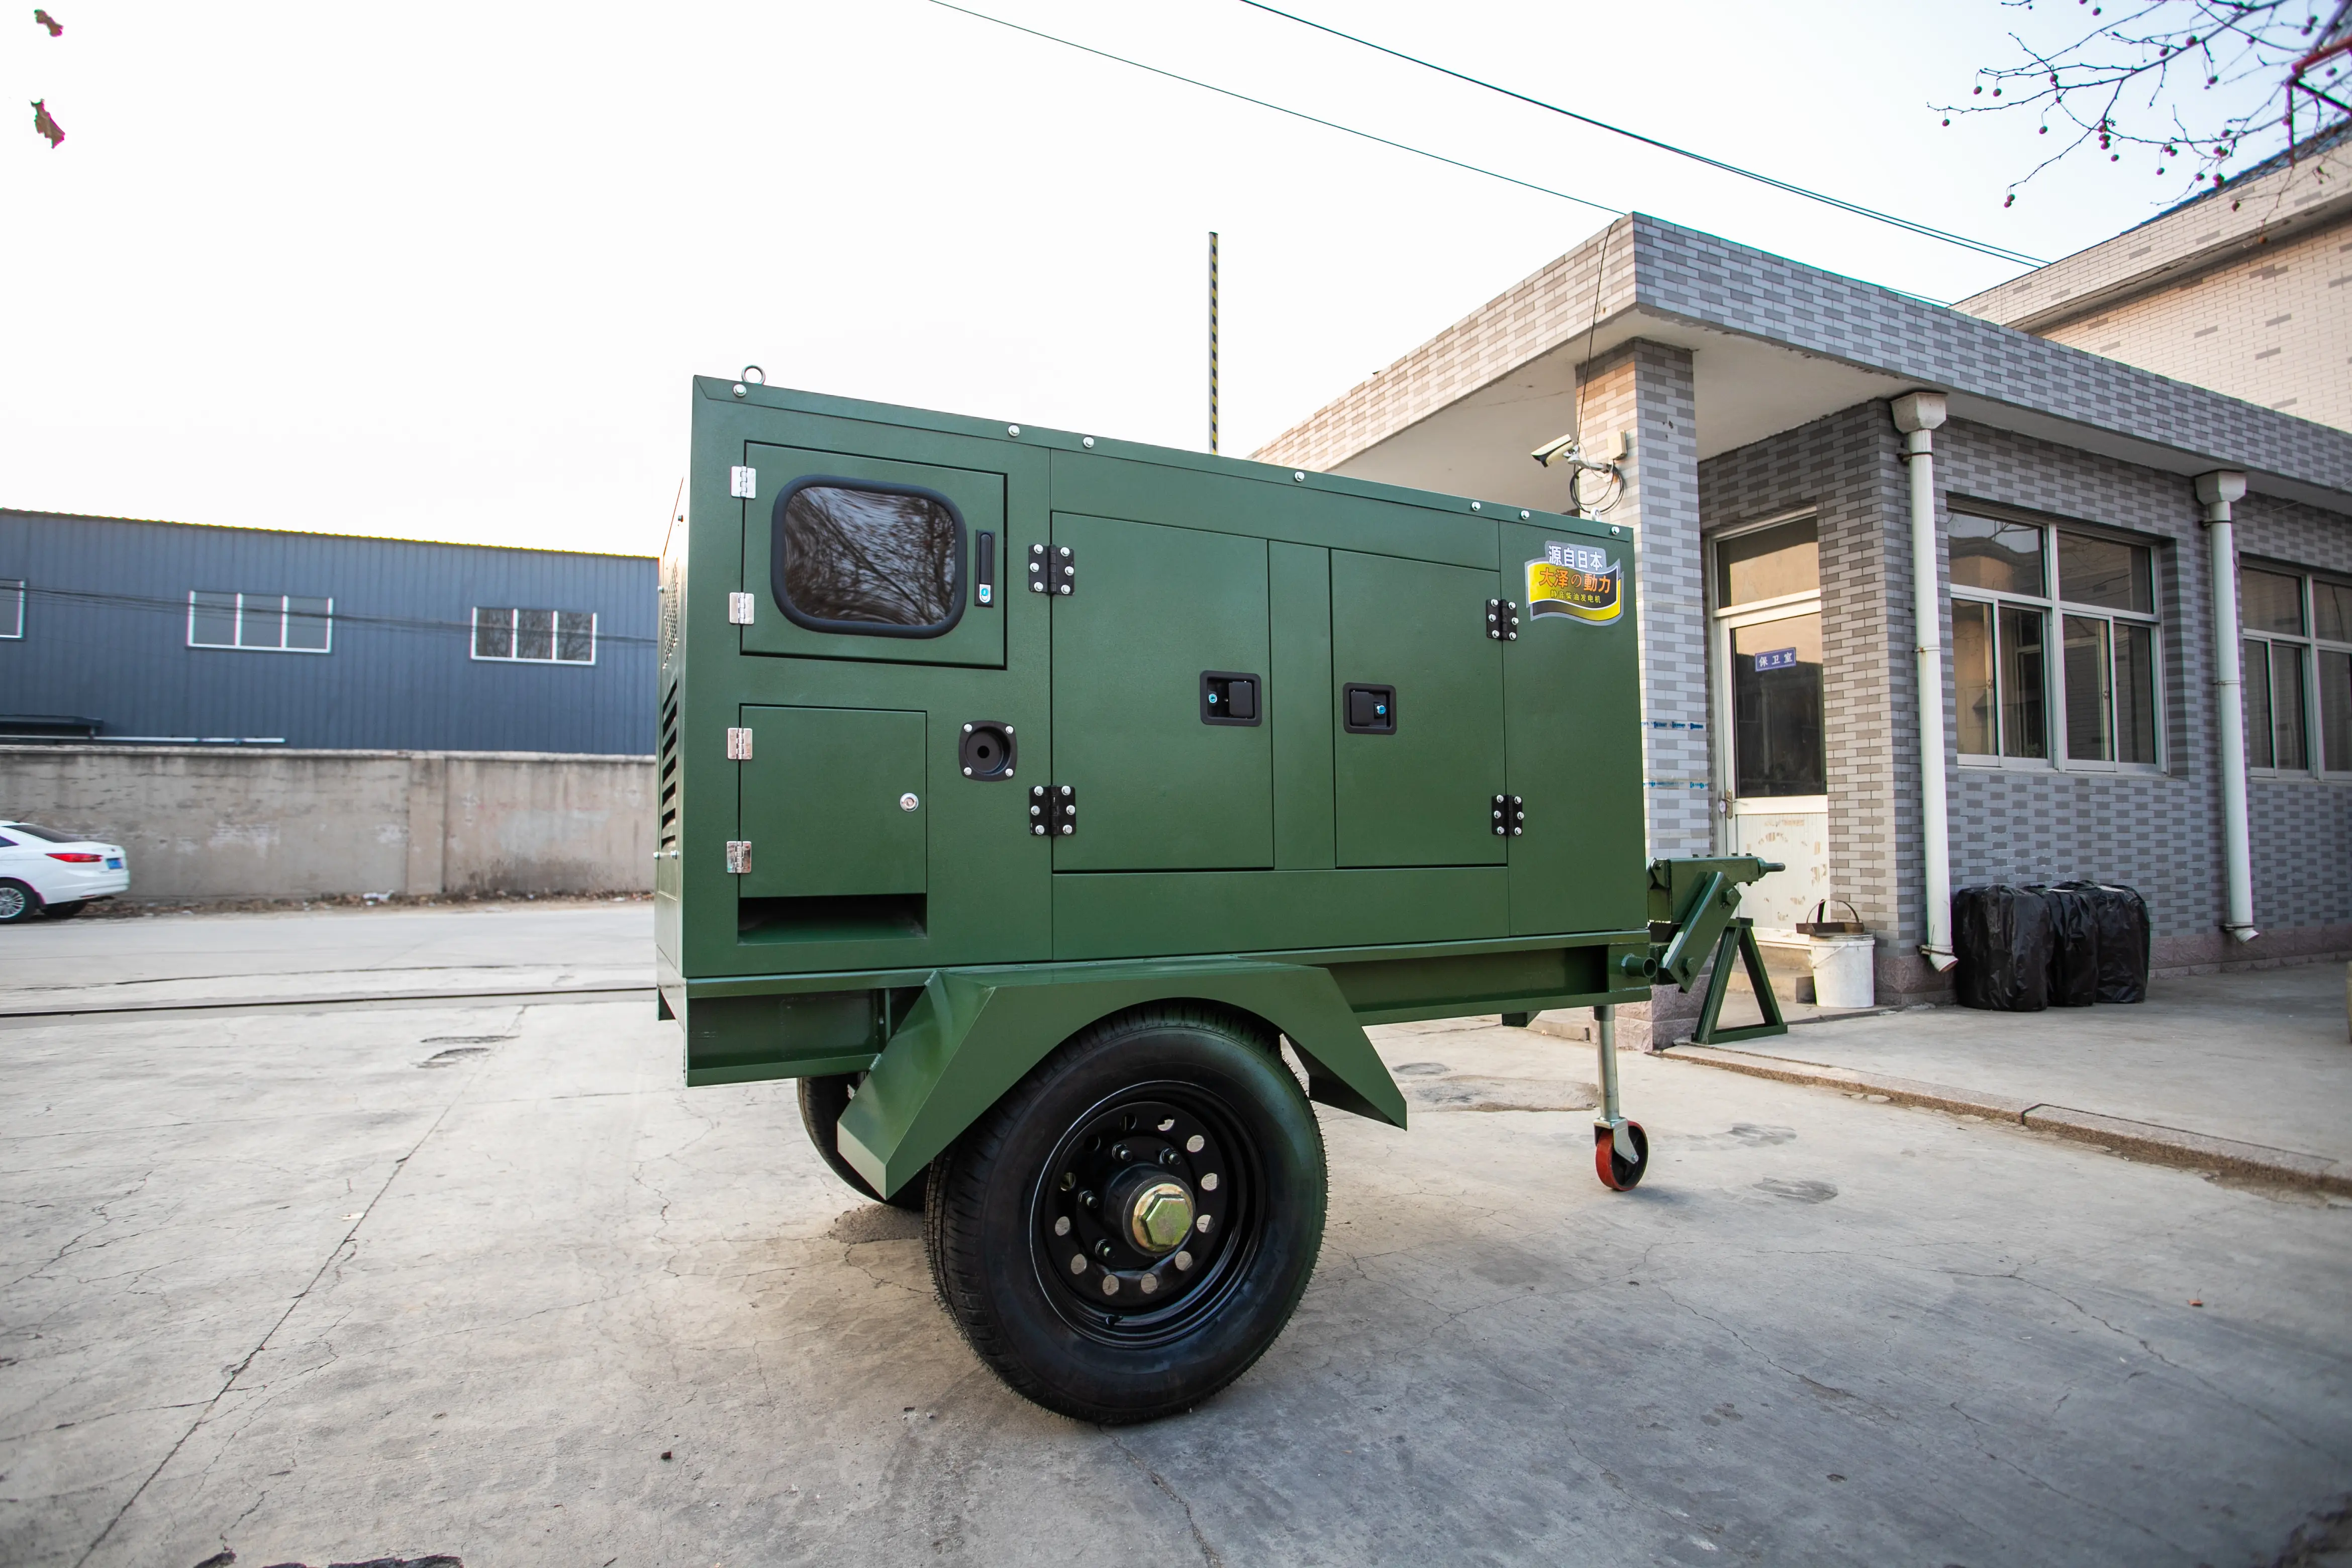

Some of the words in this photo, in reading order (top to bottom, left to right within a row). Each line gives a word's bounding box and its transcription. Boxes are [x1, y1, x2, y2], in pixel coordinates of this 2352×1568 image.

[1548, 545, 1603, 571] 源自日本
[1539, 567, 1611, 594] 大泽の動力
[1550, 590, 1601, 603] 静音柴油发电机
[1759, 652, 1792, 667] 保卫室
